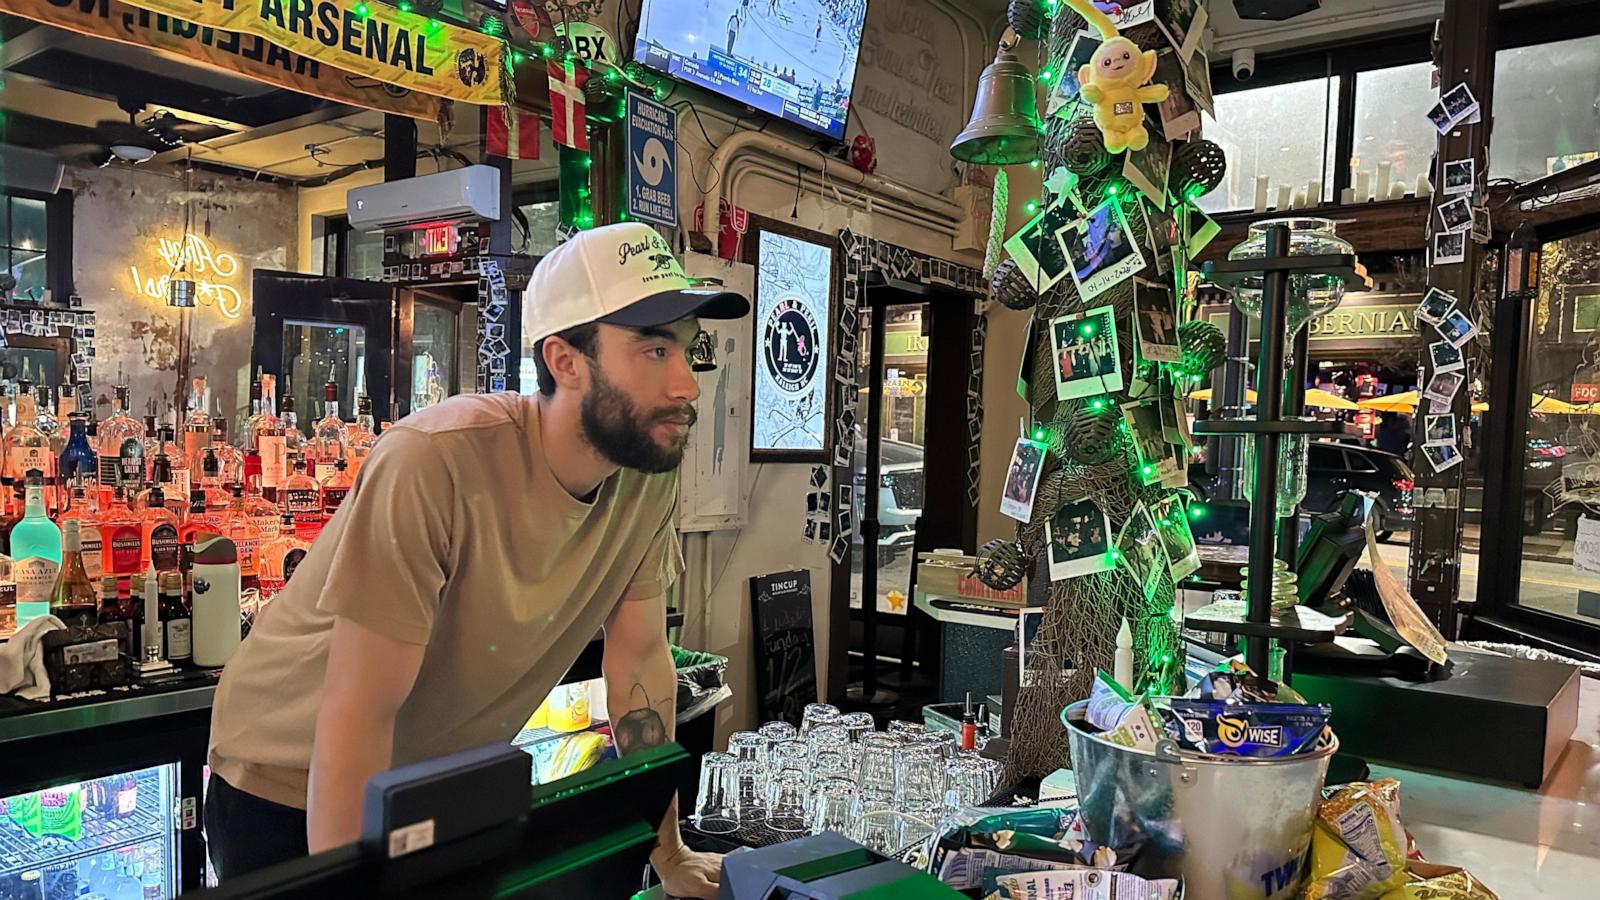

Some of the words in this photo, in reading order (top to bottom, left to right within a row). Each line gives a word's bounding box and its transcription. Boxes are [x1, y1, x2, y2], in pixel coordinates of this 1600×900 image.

[260, 0, 434, 76] ARSENAL
[637, 101, 668, 126] HURRICANE
[632, 114, 661, 136] EVACUATION
[661, 126, 674, 141] PLAN
[642, 186, 656, 202] GRAB
[657, 191, 671, 207] BEER
[639, 200, 649, 213] RUN
[650, 203, 661, 216] LIKE
[662, 206, 674, 220] HELL
[619, 235, 650, 265] Pearl
[768, 301, 790, 328] PEARL
[800, 305, 818, 333] PERIL
[775, 374, 799, 391] RALEIGH
[113, 540, 140, 548] BUSHMILLS
[771, 579, 798, 592] TINCUP
[1249, 728, 1278, 744] WISE
